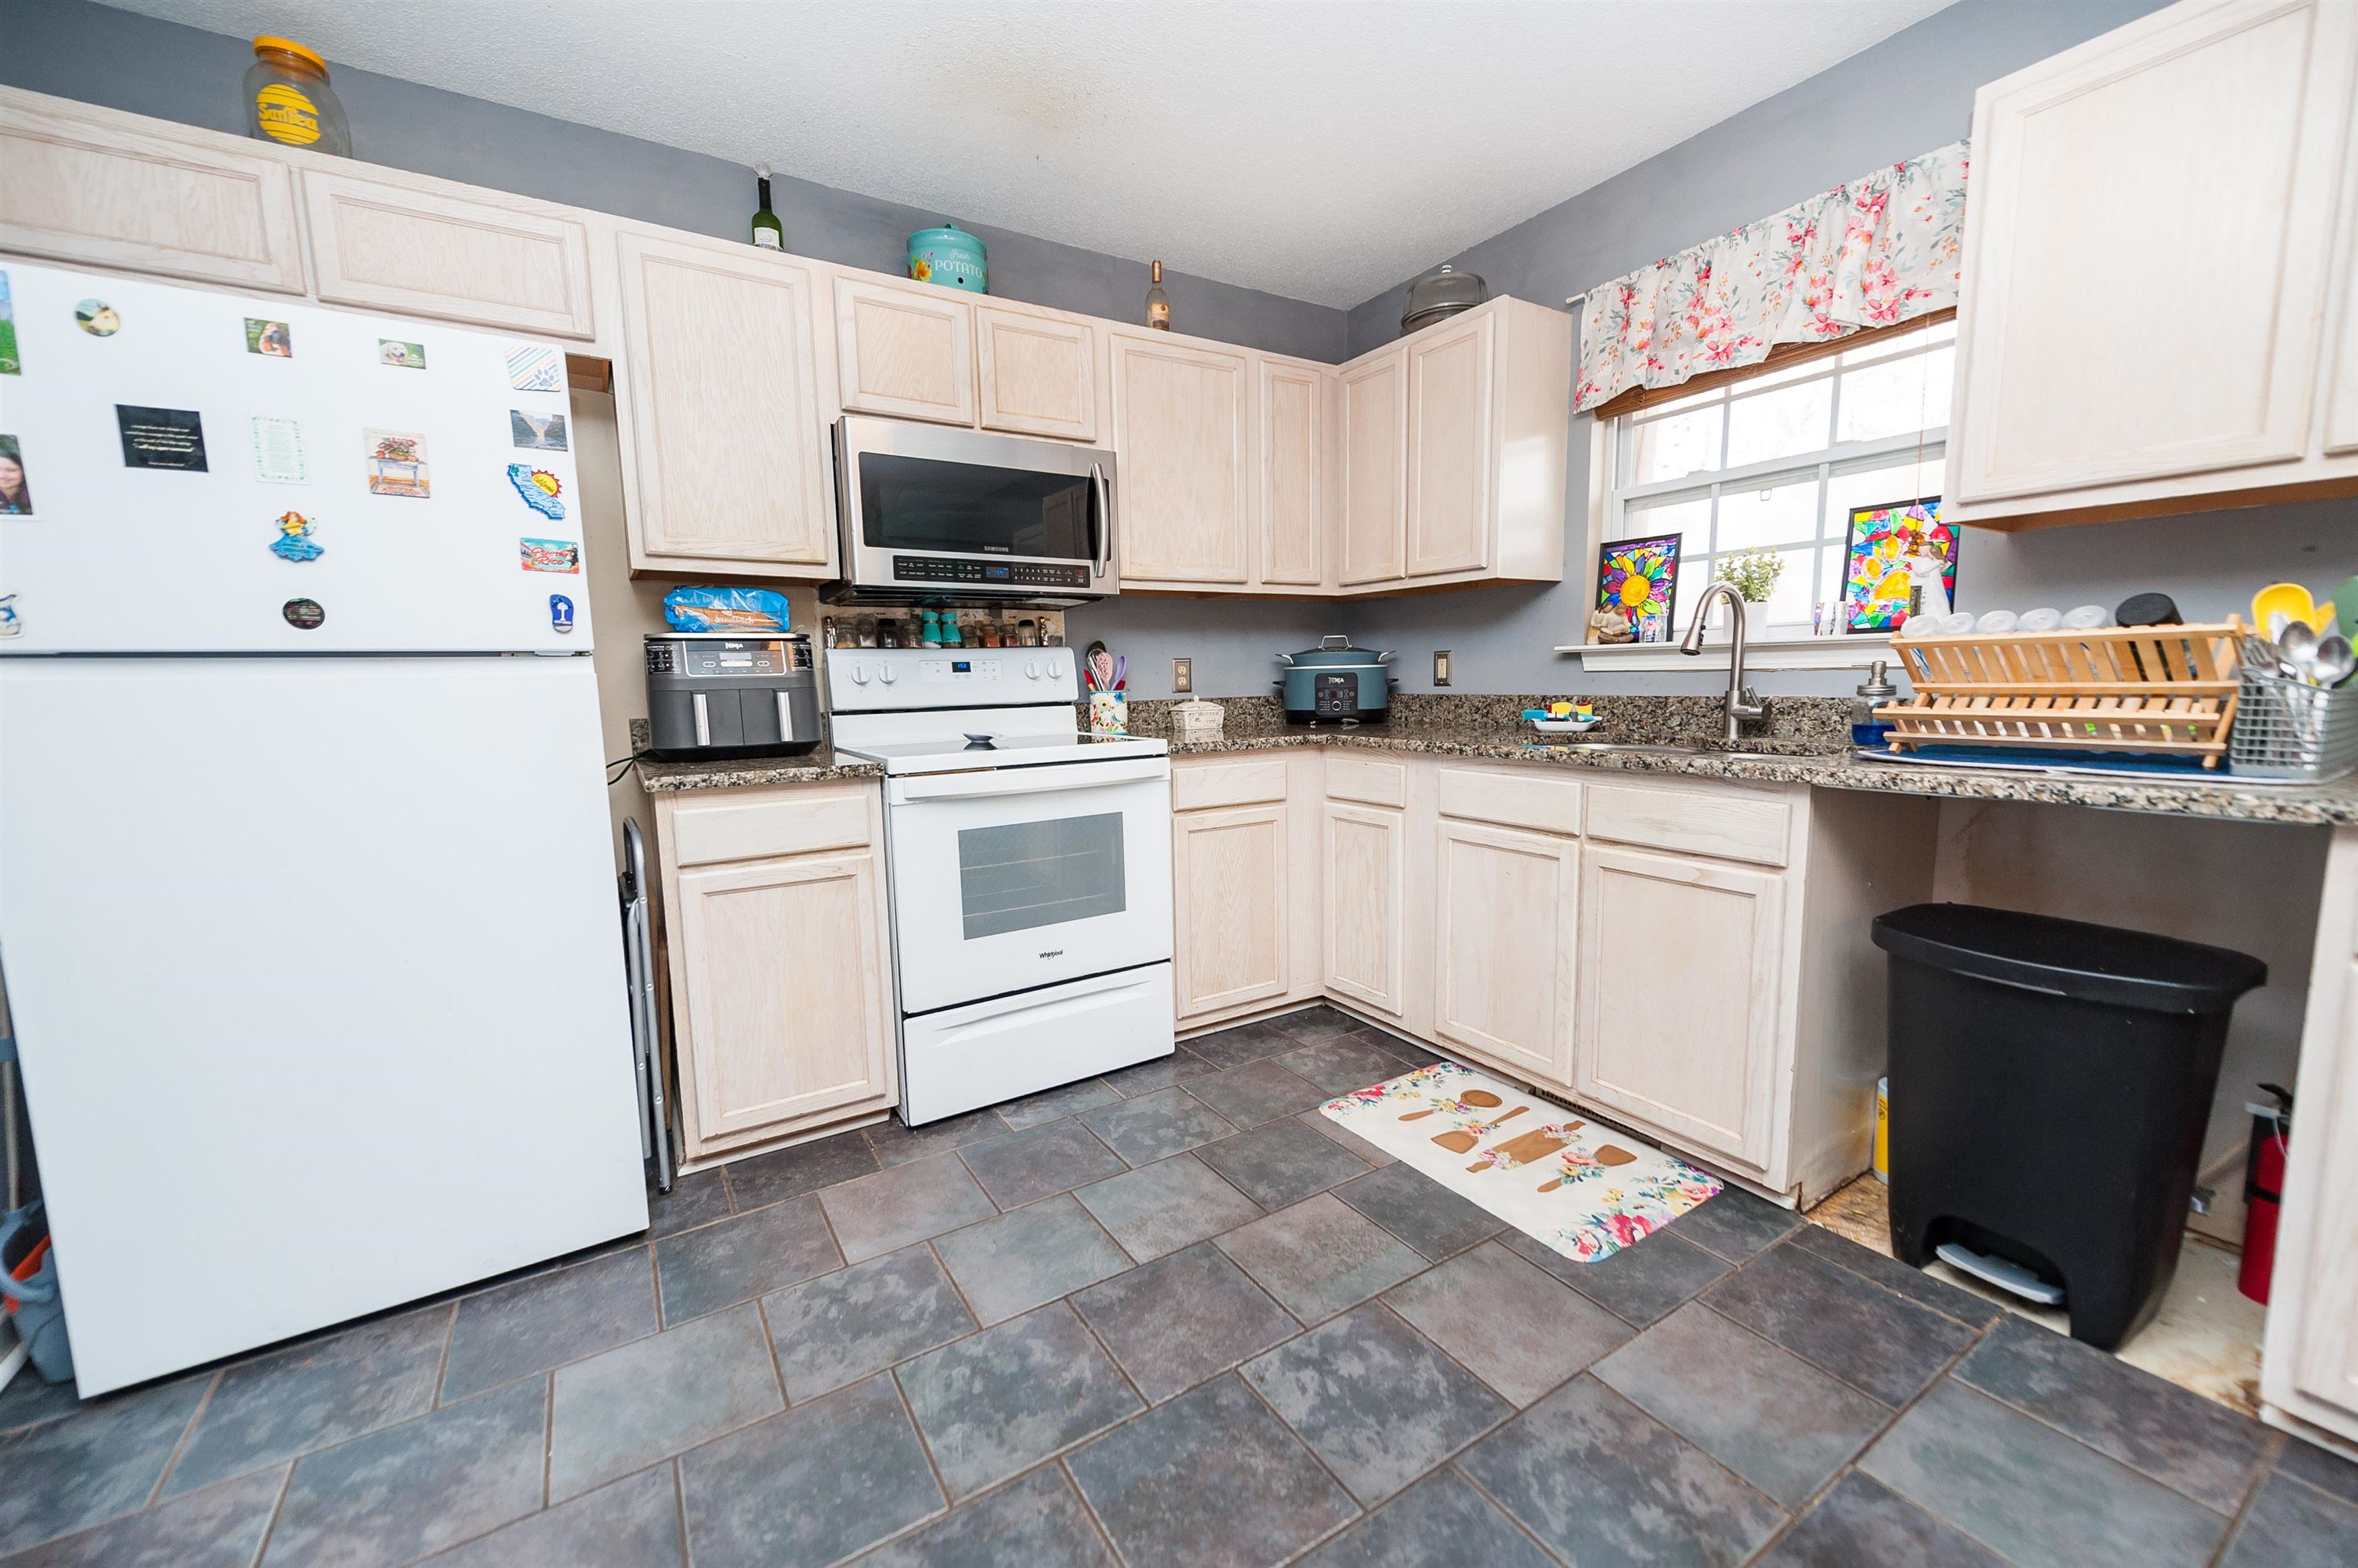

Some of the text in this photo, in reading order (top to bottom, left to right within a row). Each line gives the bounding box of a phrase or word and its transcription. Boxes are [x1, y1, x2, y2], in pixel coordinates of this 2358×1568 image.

[949, 249, 970, 260] Fresh
[935, 259, 982, 279] POTATO
[535, 556, 564, 566] Rico
[725, 642, 744, 650] NINJA
[1329, 676, 1345, 685] NINJA
[1039, 949, 1063, 959] Whirlpool
